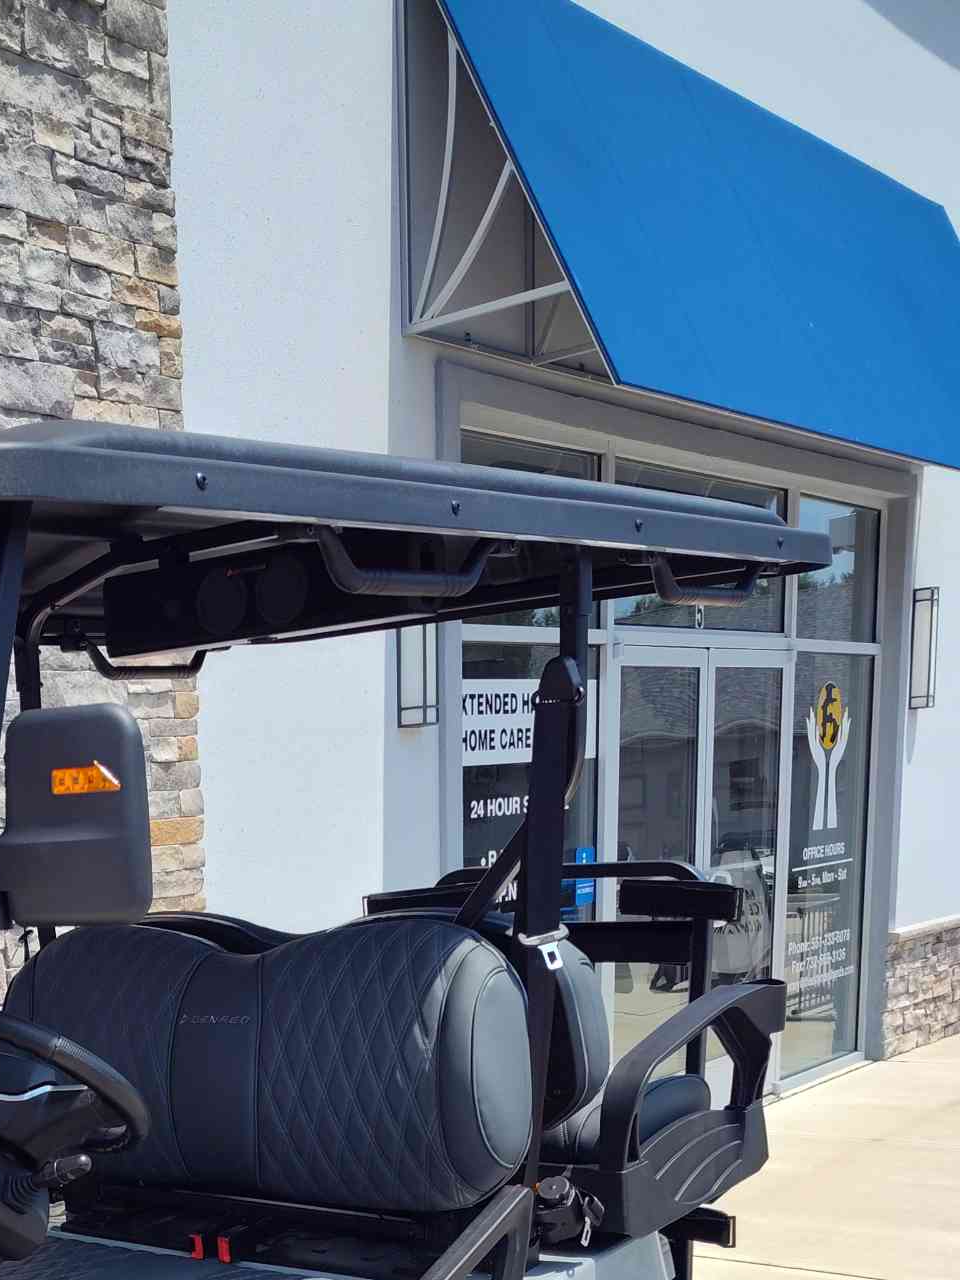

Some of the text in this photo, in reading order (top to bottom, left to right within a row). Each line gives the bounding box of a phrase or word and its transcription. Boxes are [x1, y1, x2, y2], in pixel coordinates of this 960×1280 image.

[500, 727, 532, 750] CARE
[470, 799, 485, 819] 24
[487, 796, 521, 817] HOUR
[803, 842, 846, 860] OFFICE HOURS
